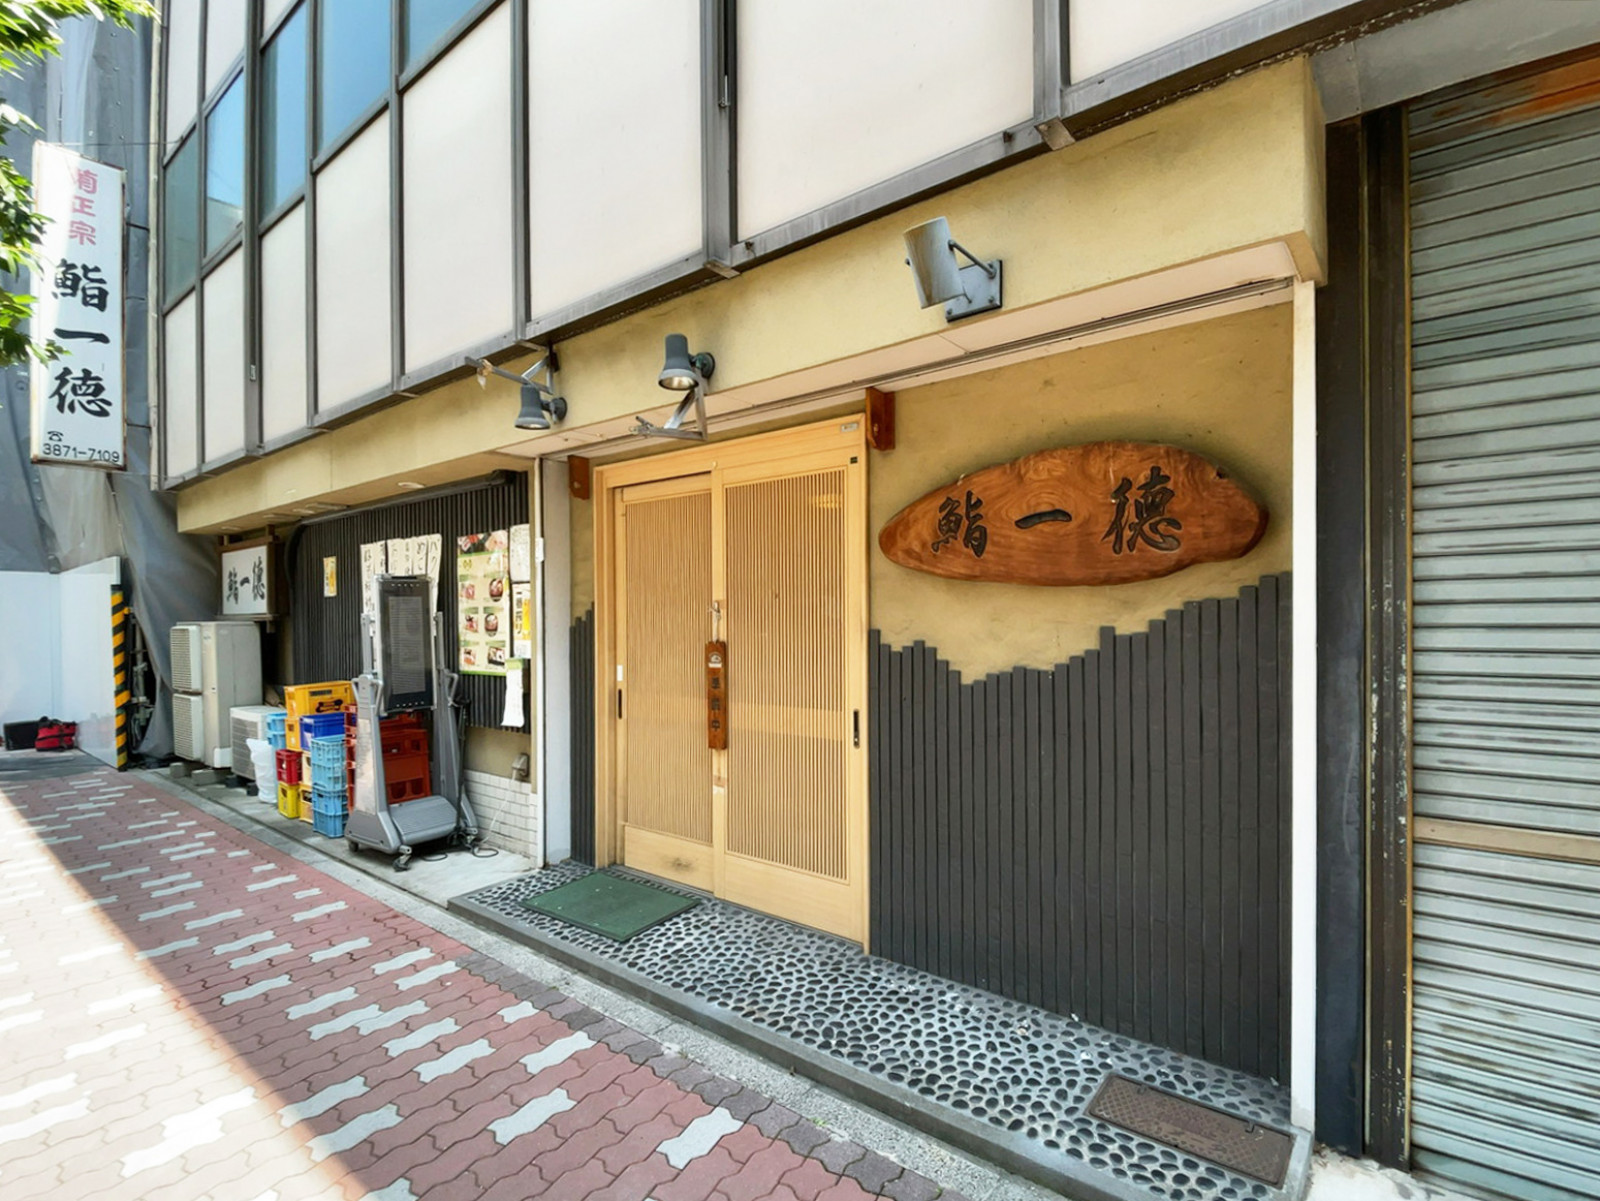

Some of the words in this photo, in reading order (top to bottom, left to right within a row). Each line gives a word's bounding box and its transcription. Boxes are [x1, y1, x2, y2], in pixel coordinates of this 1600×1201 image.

[49, 258, 113, 417] 鮨一徳
[42, 443, 120, 463] 3871-7109
[930, 465, 1182, 558] 鮨一徳
